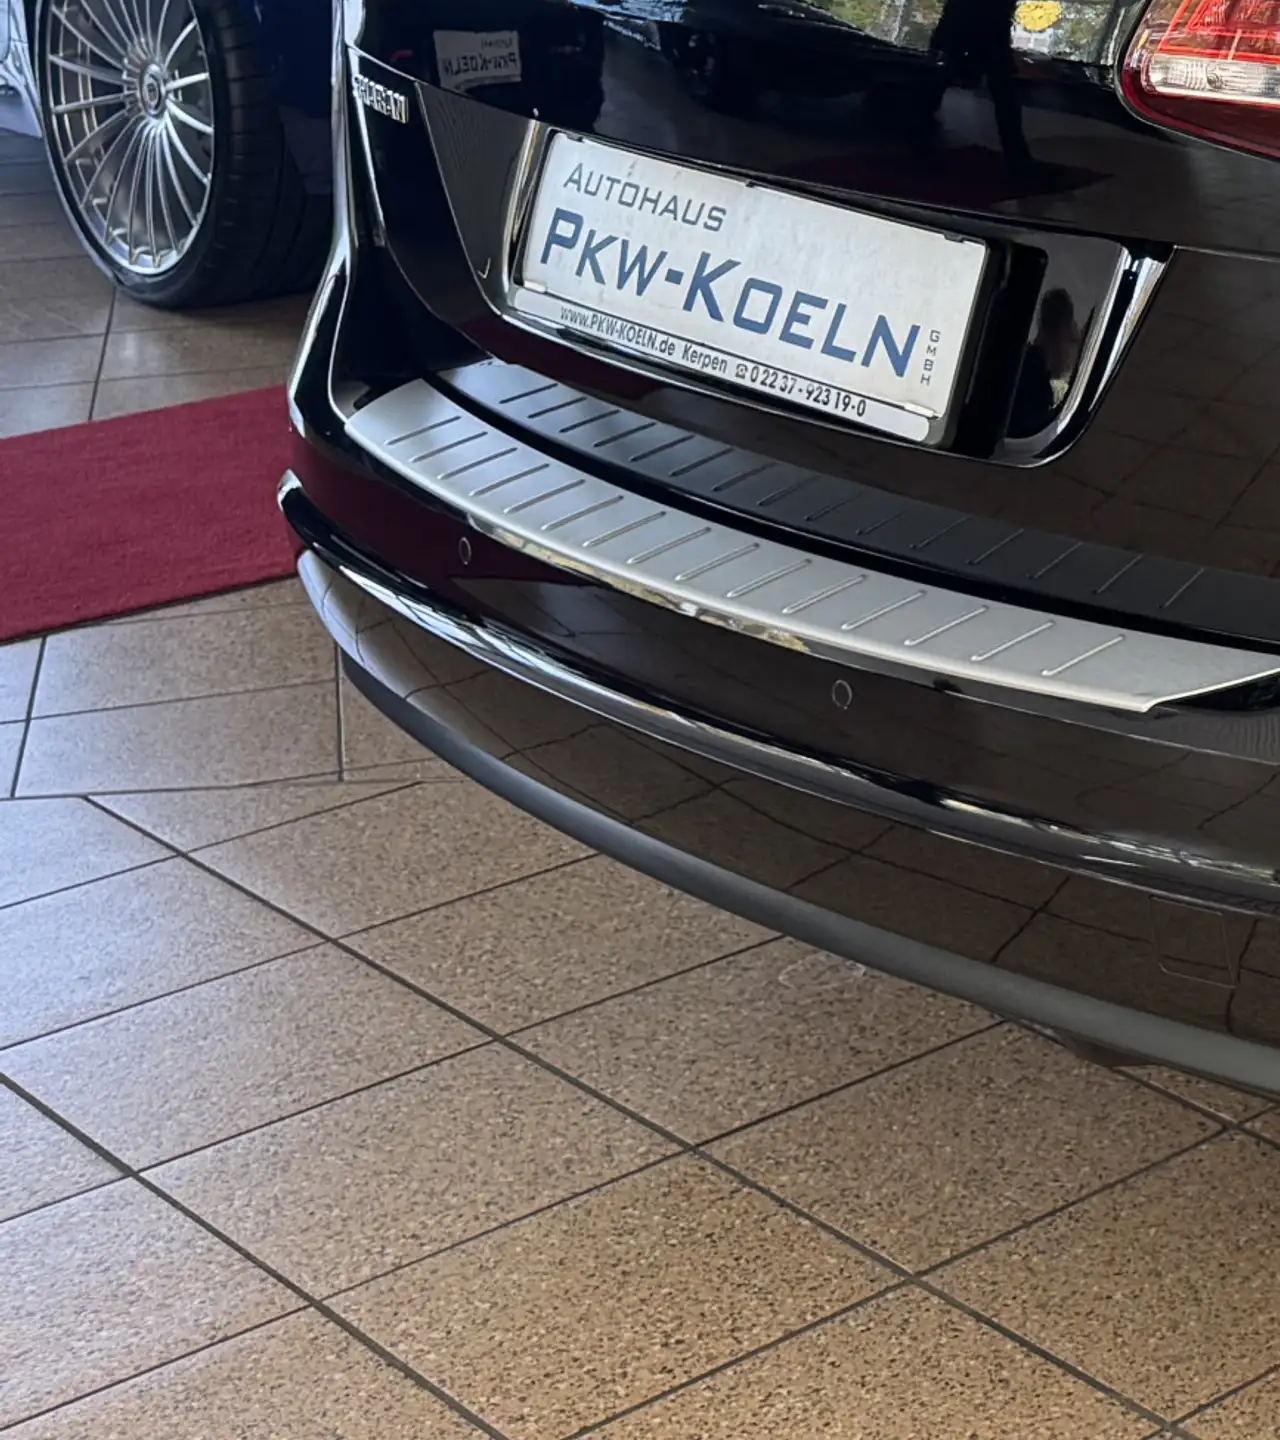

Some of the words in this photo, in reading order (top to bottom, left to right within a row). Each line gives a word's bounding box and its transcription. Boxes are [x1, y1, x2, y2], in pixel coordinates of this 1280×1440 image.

[563, 162, 728, 233] AUTOHAUS
[540, 207, 921, 378] PKW-KOELN
[560, 306, 676, 357] www.PKW-KOELN.de
[682, 343, 728, 374] Kerpen
